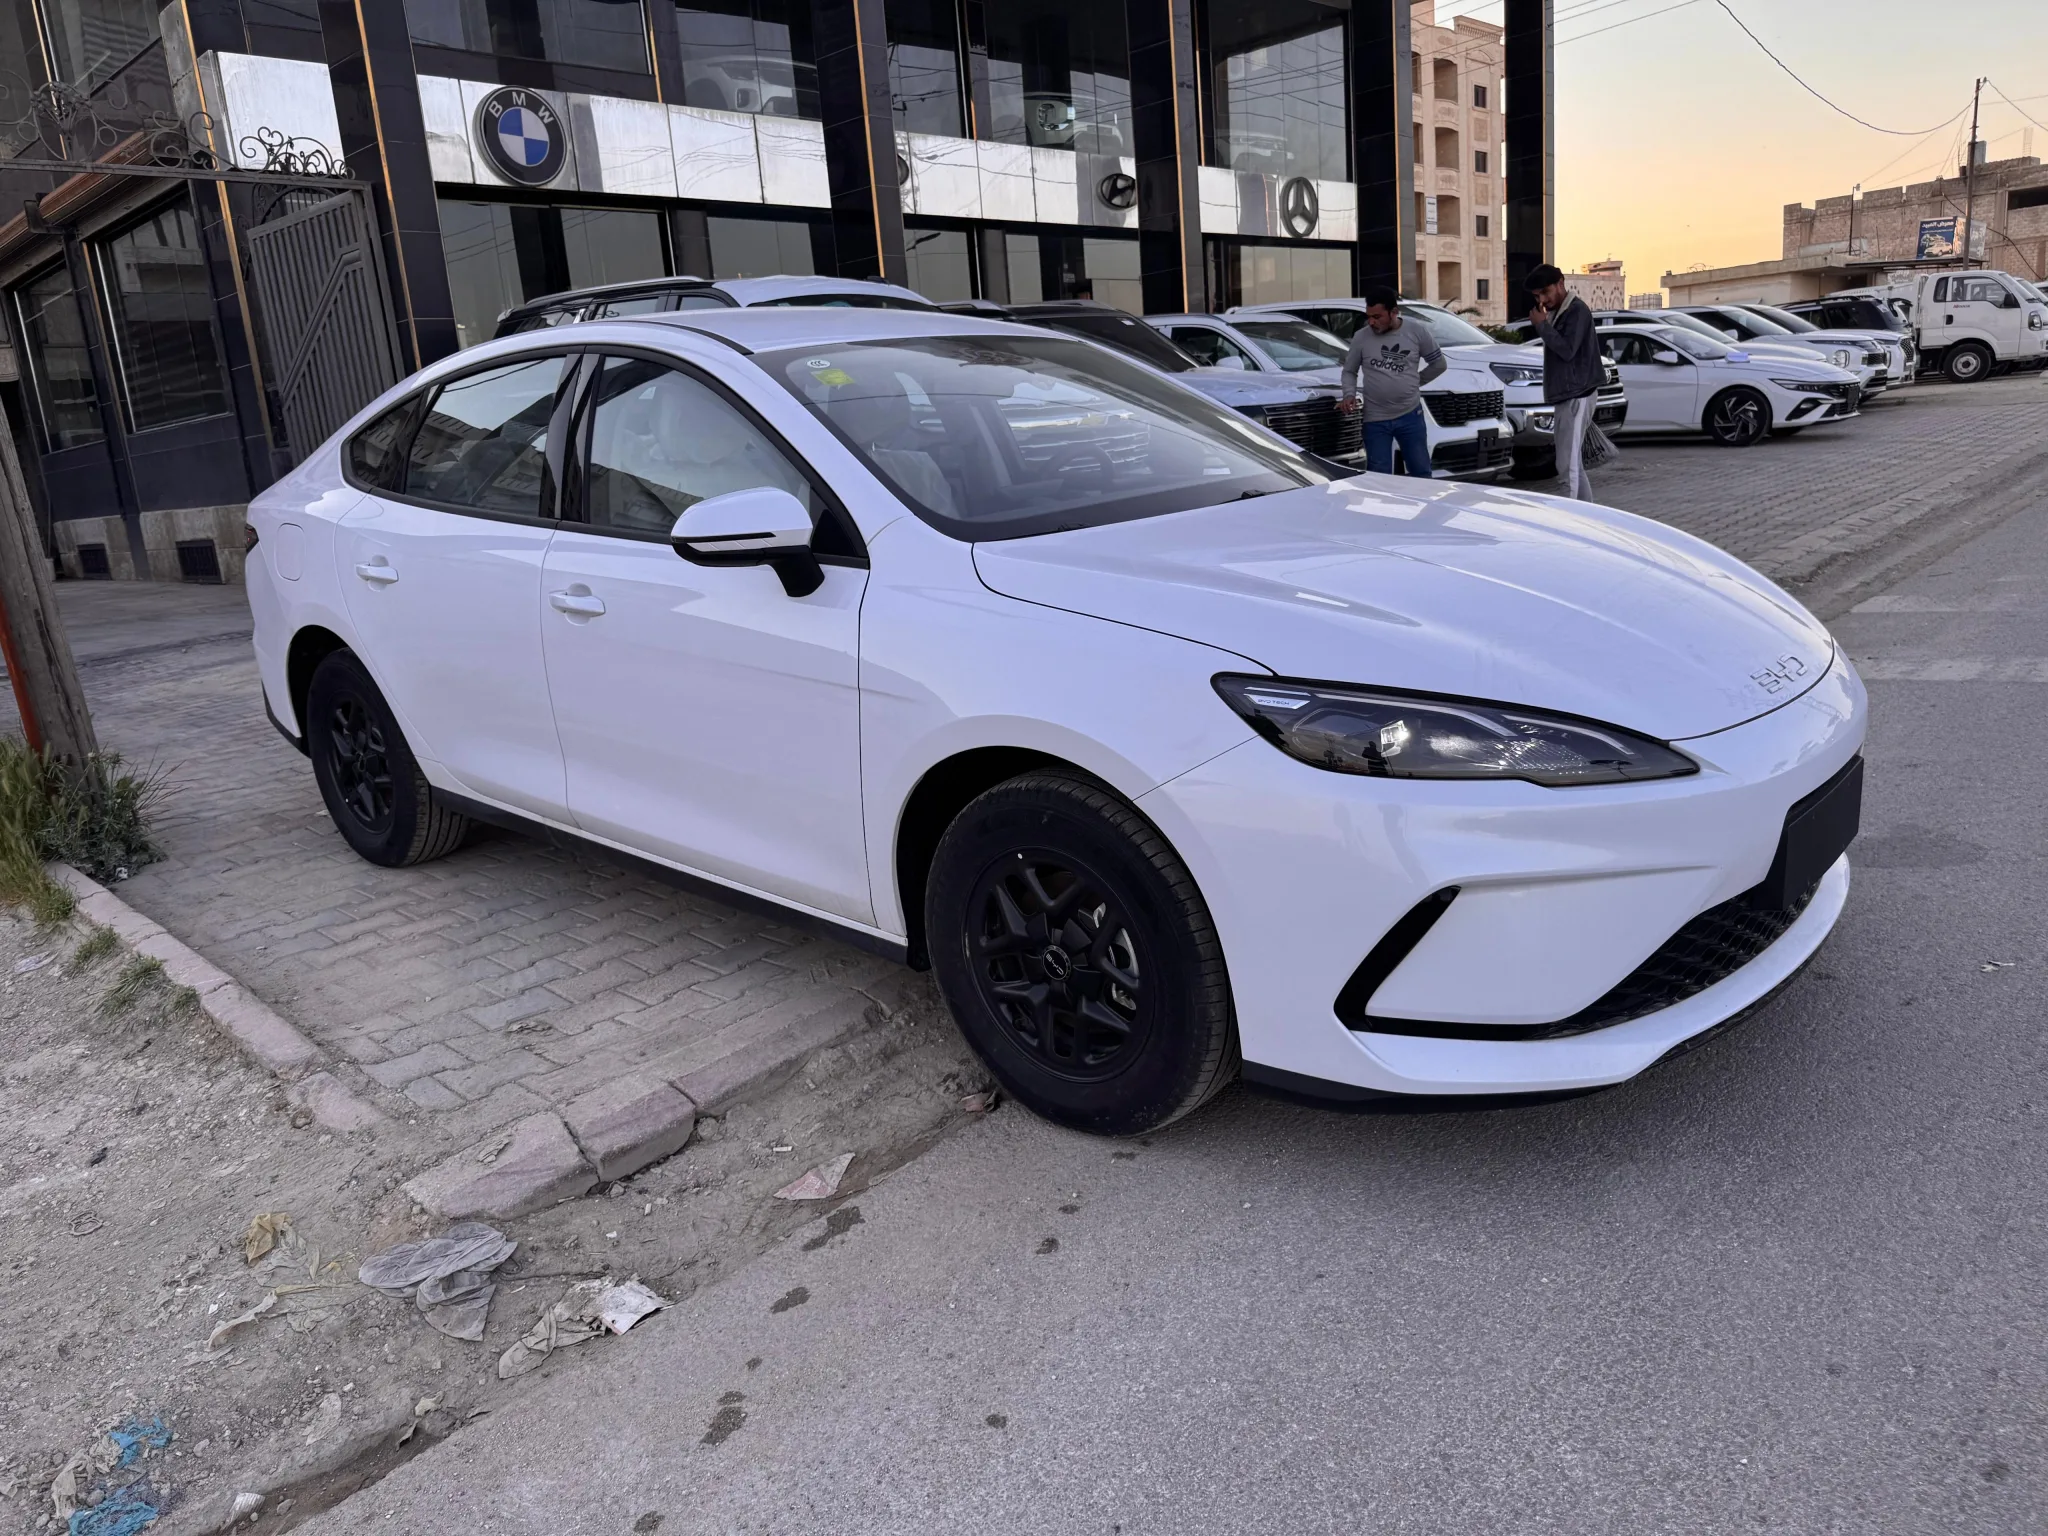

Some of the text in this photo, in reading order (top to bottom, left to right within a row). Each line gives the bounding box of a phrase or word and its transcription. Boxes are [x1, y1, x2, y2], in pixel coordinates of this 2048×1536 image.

[488, 91, 555, 125] BMW
[1370, 358, 1406, 373] adidas
[1748, 652, 1809, 694] BYD
[1045, 953, 1064, 976] BYD
